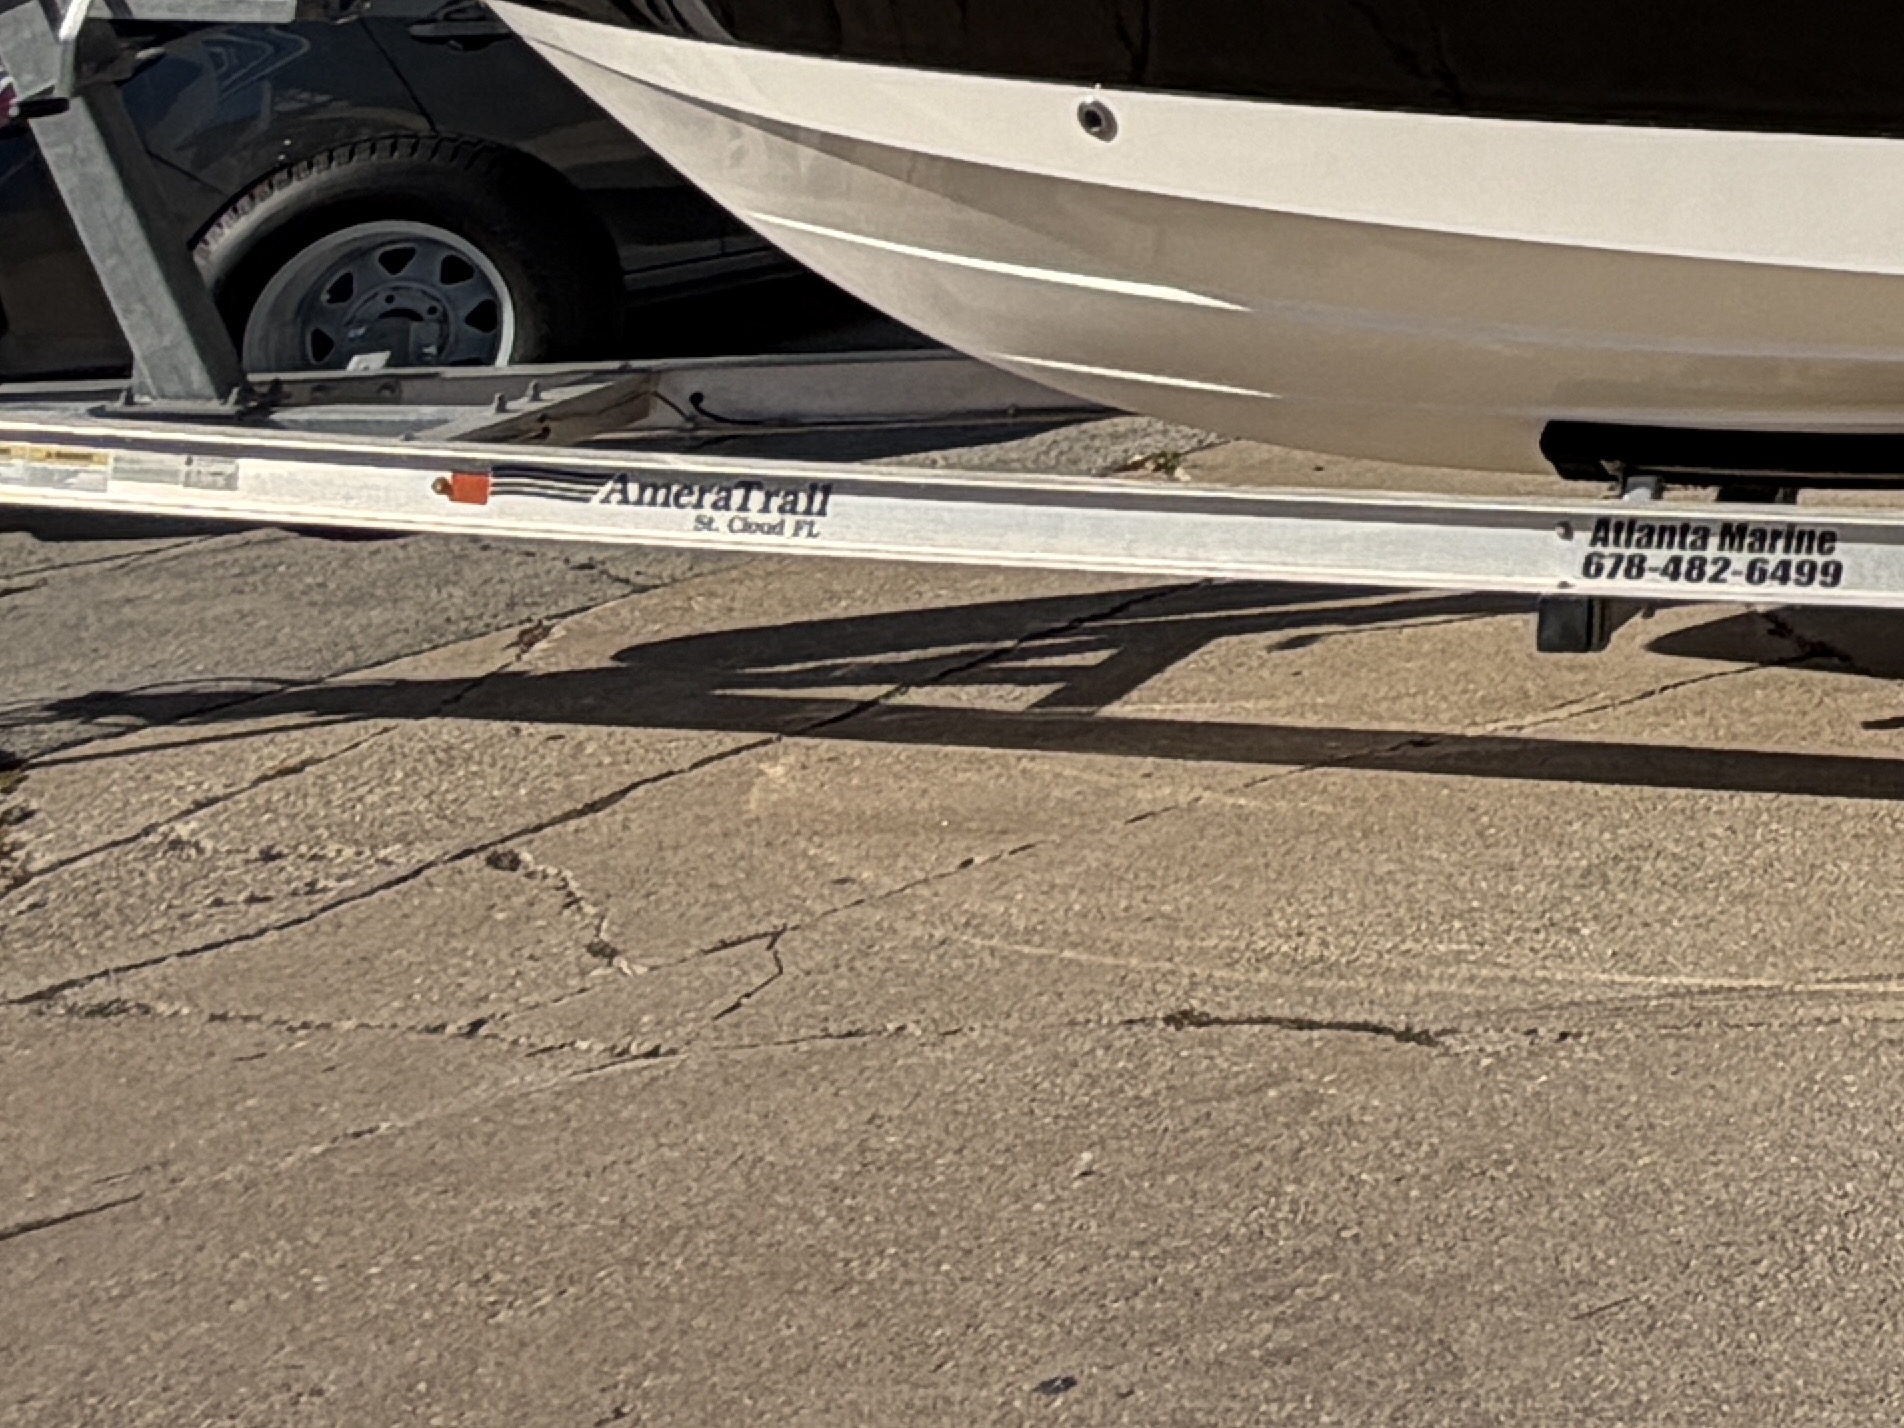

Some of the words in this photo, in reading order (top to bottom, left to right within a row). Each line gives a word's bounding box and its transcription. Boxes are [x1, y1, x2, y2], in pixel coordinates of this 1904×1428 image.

[600, 472, 834, 517] AmeraTrail
[693, 514, 720, 532] St.
[727, 515, 786, 537] Cloud
[790, 519, 822, 539] FL
[1589, 518, 1711, 552] Atlanta
[1716, 521, 1838, 556] Marine
[1581, 550, 1844, 588] 678-482-6499
